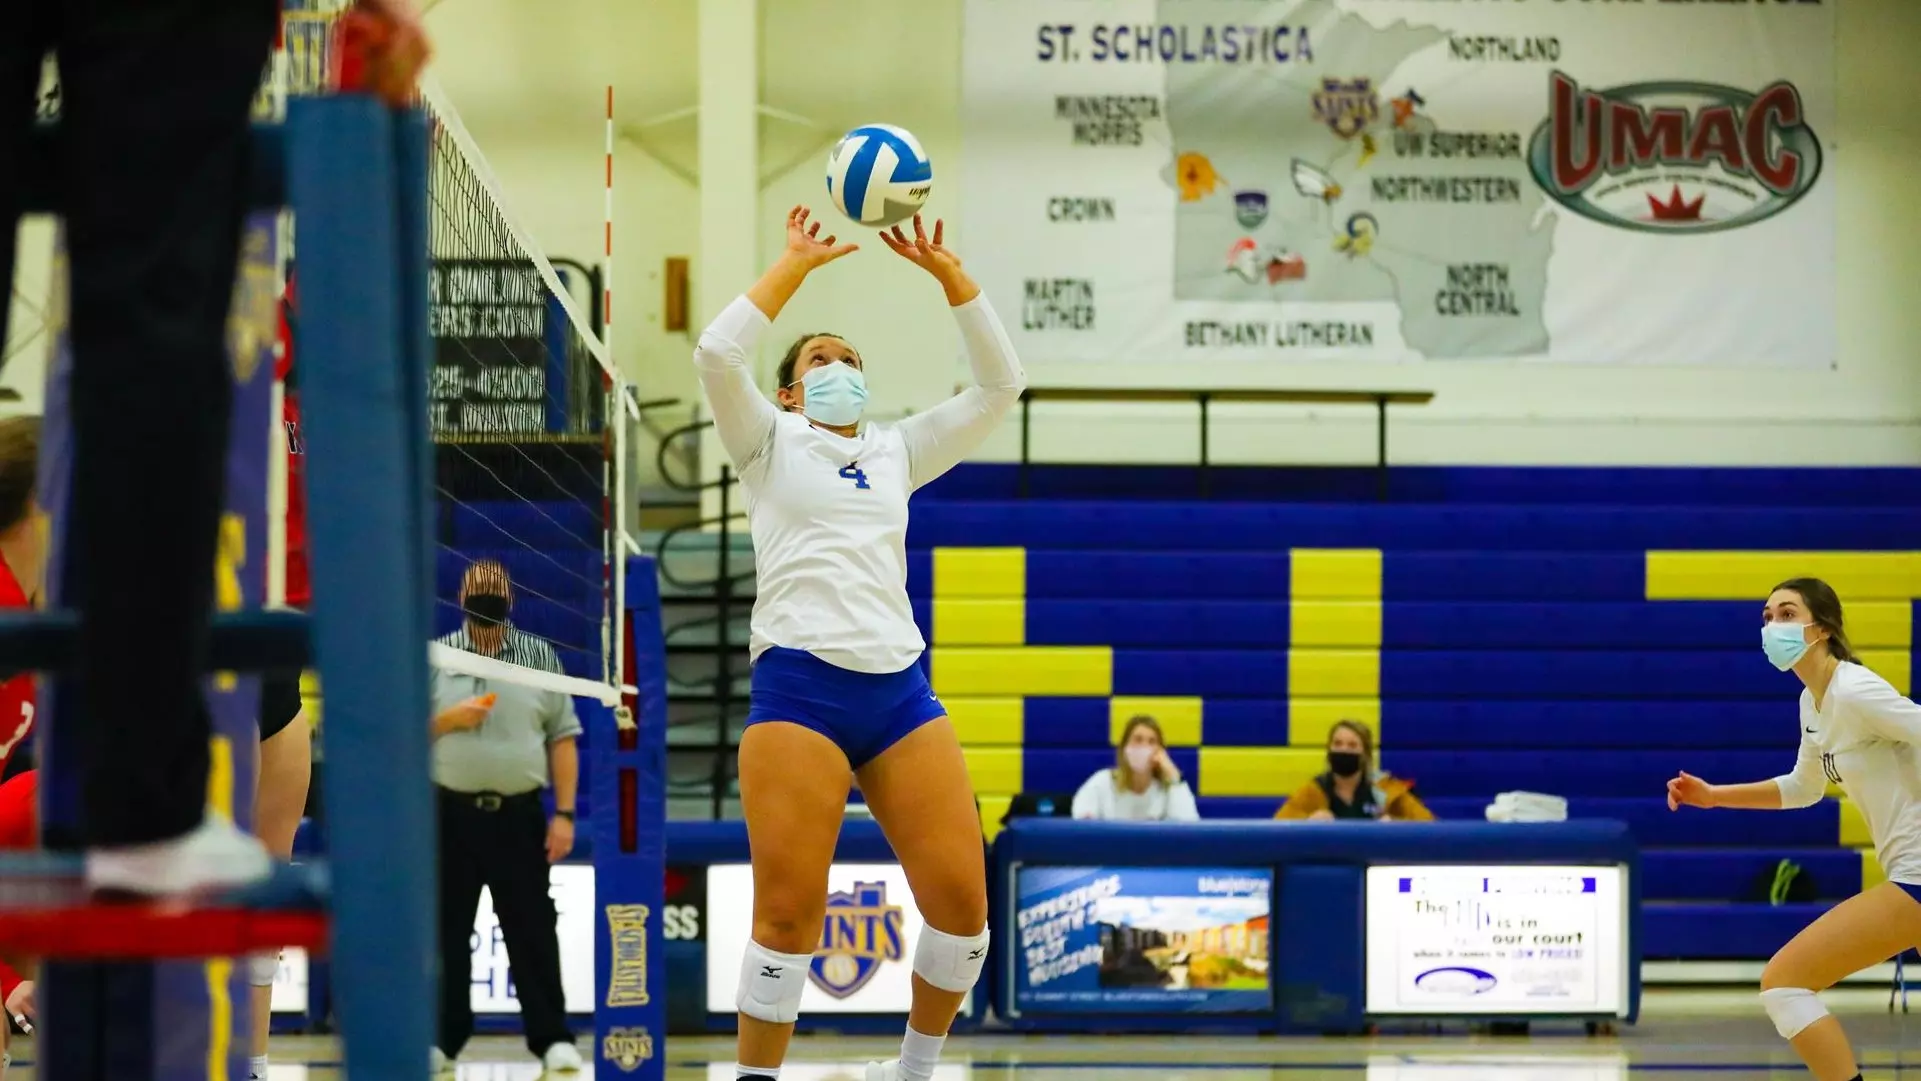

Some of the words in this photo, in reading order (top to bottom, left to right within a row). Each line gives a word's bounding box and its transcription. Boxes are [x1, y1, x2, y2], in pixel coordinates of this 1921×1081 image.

[1037, 26, 1079, 61] ST.
[1091, 26, 1313, 62] SCHOLASTICA
[1448, 37, 1561, 62] NORTHLAND
[1055, 95, 1160, 119] MINNESOTA
[1073, 121, 1142, 145] MORRIS
[1430, 133, 1521, 157] SUPERIOR
[1549, 69, 1801, 196] UMAC
[1371, 177, 1521, 203] NORTHWESTERN
[1048, 198, 1115, 221] CROWN
[1446, 264, 1509, 289] NORTH
[1024, 279, 1093, 300] MARTIN
[1435, 289, 1520, 317] CENTRAL
[1022, 303, 1095, 330] LUTHER
[1185, 321, 1266, 347] BETHANY
[1276, 321, 1373, 347] LUTHERAN
[838, 460, 871, 490] 4
[1492, 934, 1523, 945] our
[1533, 932, 1584, 945] court
